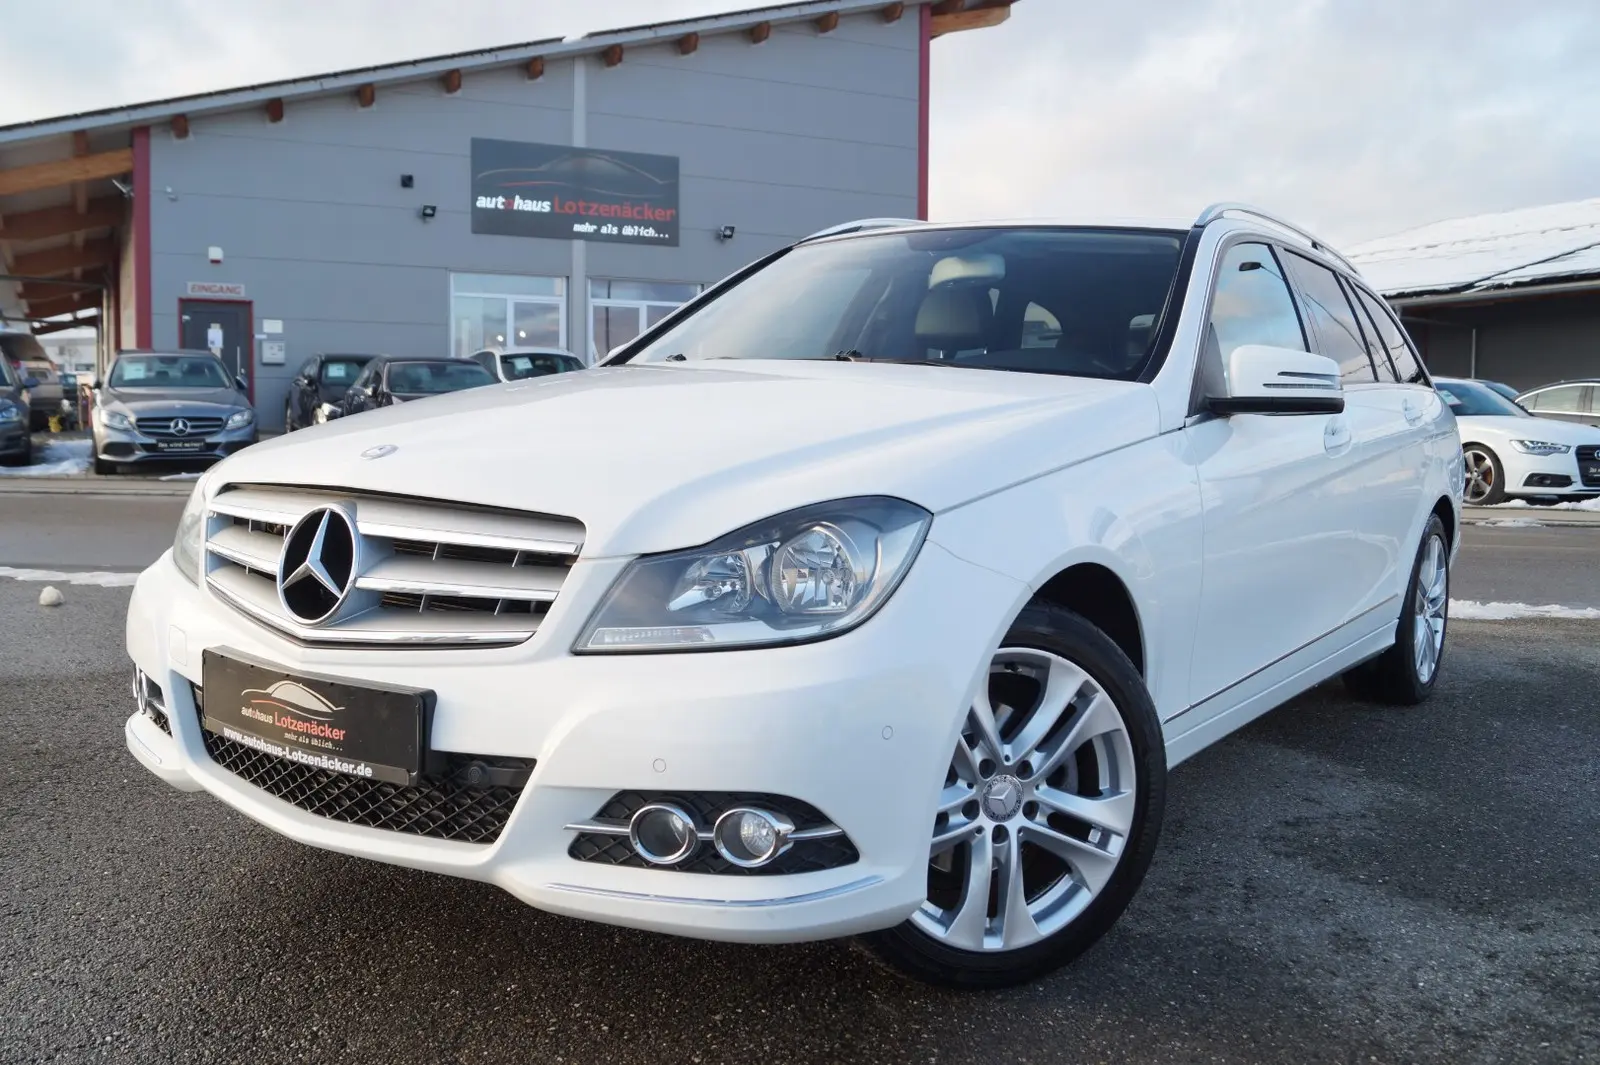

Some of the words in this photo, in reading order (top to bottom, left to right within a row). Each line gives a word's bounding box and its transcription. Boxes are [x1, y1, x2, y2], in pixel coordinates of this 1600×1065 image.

[475, 194, 551, 212] autohaus
[554, 194, 675, 221] Lotzenäcker
[573, 222, 598, 233] mehr
[600, 224, 618, 235] als
[621, 225, 669, 238] üblich...
[190, 284, 242, 294] EINGANG
[241, 706, 273, 724] autohaus
[274, 711, 346, 741] Lotzenäcker
[284, 731, 298, 741] mehr
[299, 735, 310, 743] als
[223, 726, 373, 777] www.autohaus-Lotzenäcker.de
